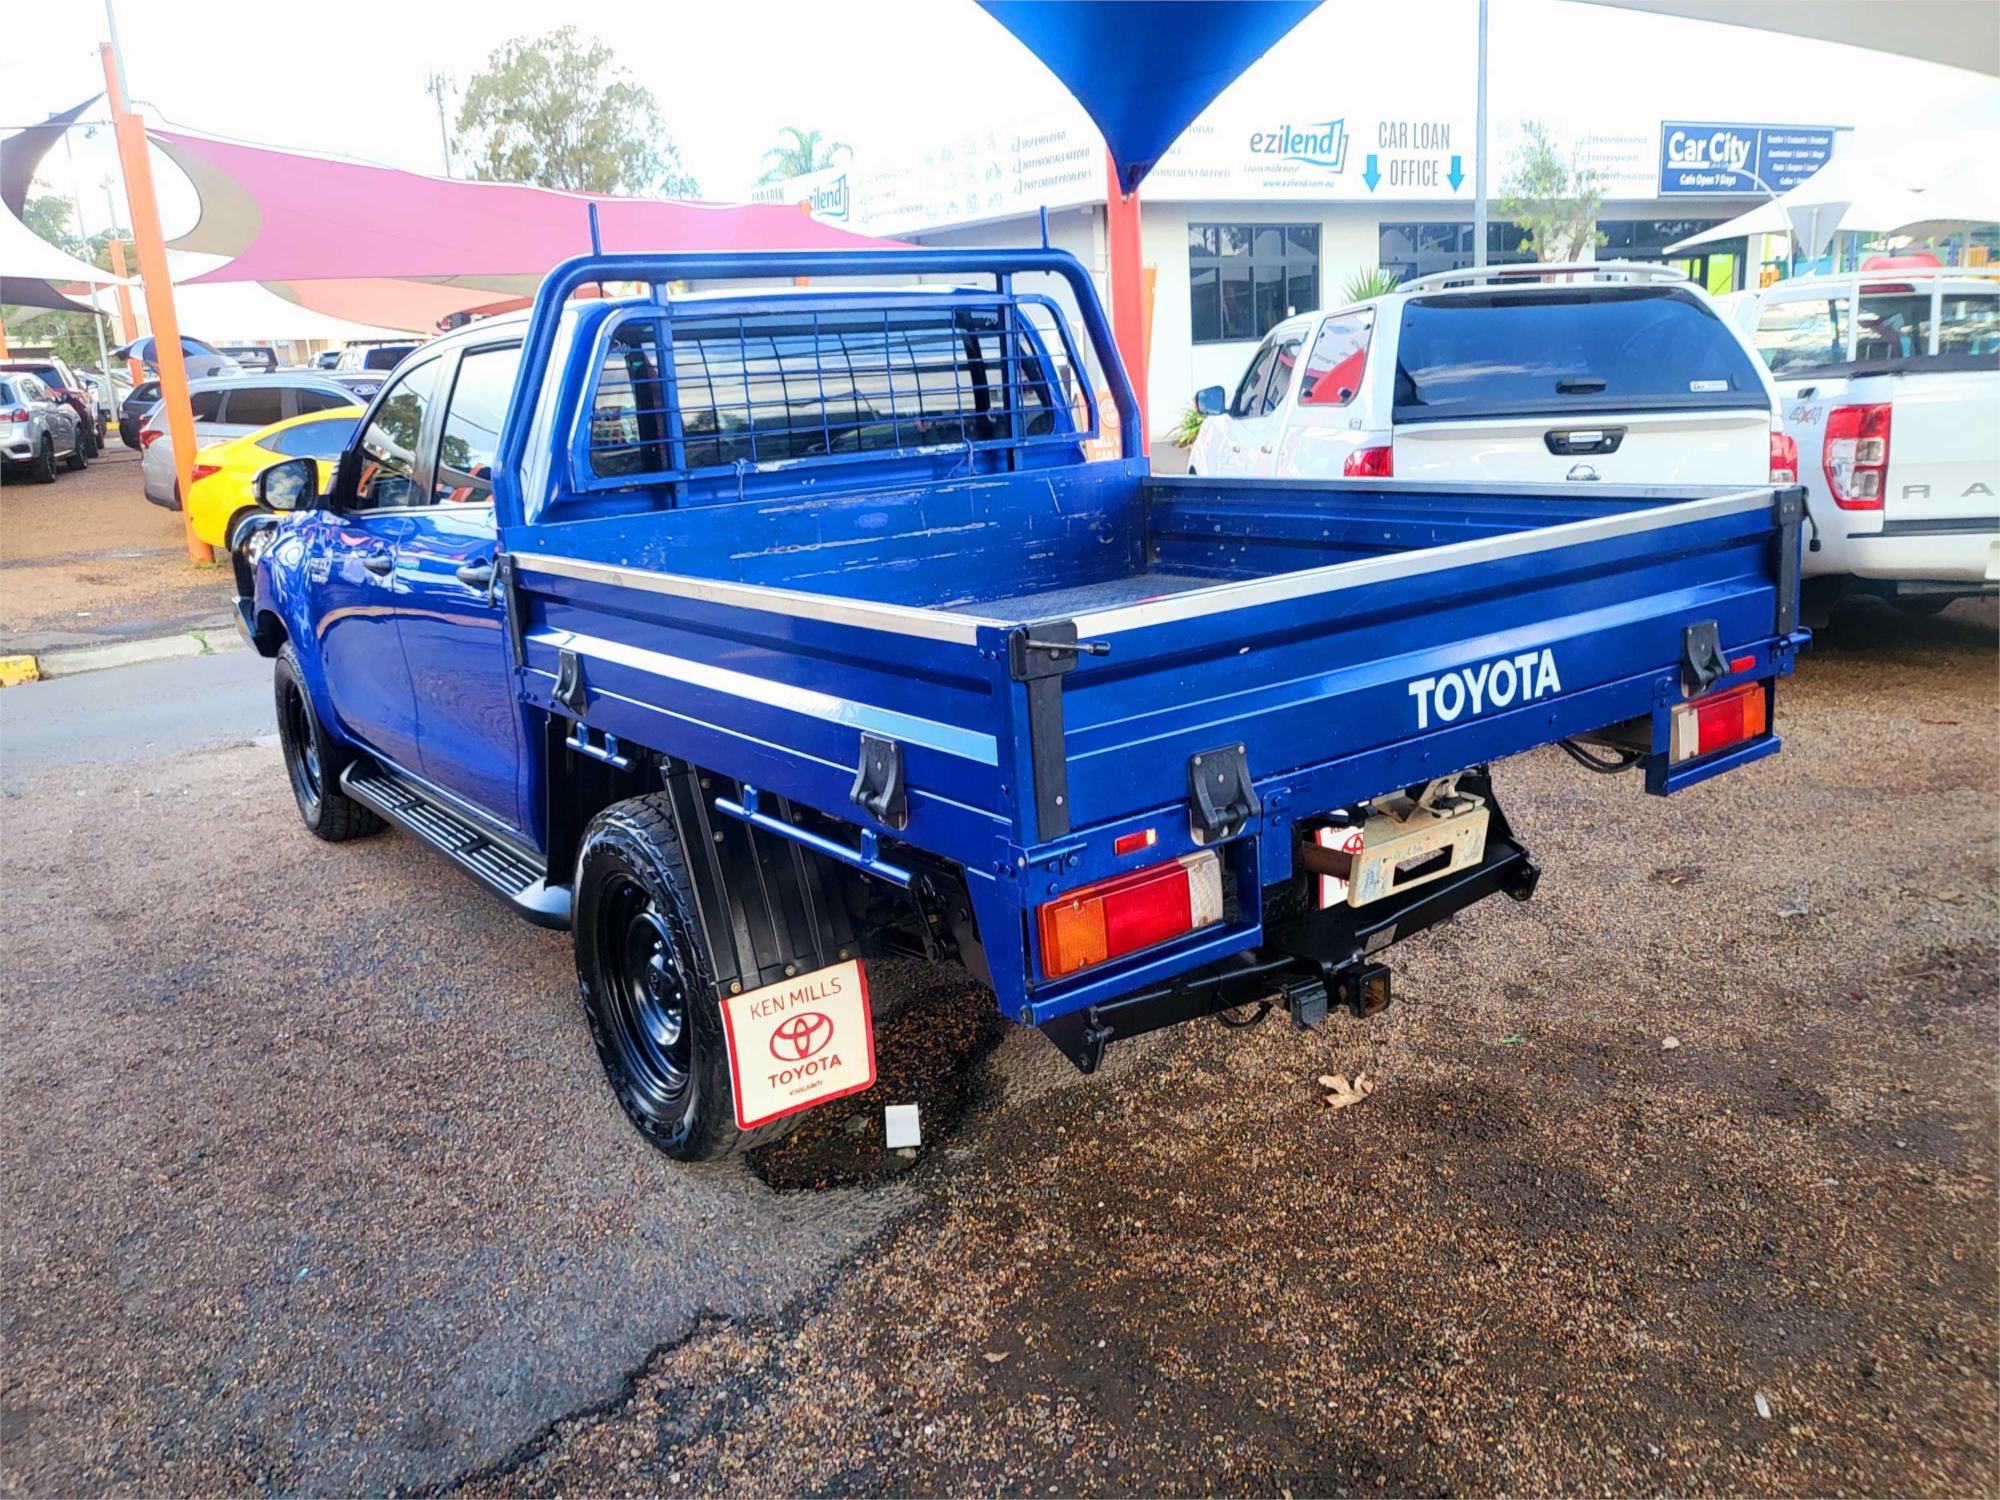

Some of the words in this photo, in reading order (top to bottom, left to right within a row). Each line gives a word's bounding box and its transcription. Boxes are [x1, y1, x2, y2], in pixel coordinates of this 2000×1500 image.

[1249, 119, 1334, 155] ezilend
[1378, 121, 1408, 149] CAR
[1413, 122, 1450, 151] LOAN
[1668, 129, 1708, 162] Car
[1709, 131, 1751, 169] City
[1152, 168, 1198, 178] POINTMENT
[1390, 159, 1439, 186] OFFICE
[1696, 173, 1715, 187] Open
[1719, 174, 1737, 187] Days
[1788, 406, 1823, 425] 4x4
[1408, 648, 1562, 730] TOYOTA
[750, 994, 785, 1021] KEN
[790, 977, 842, 1009] MILLS
[768, 1053, 842, 1089] TOYOTA
